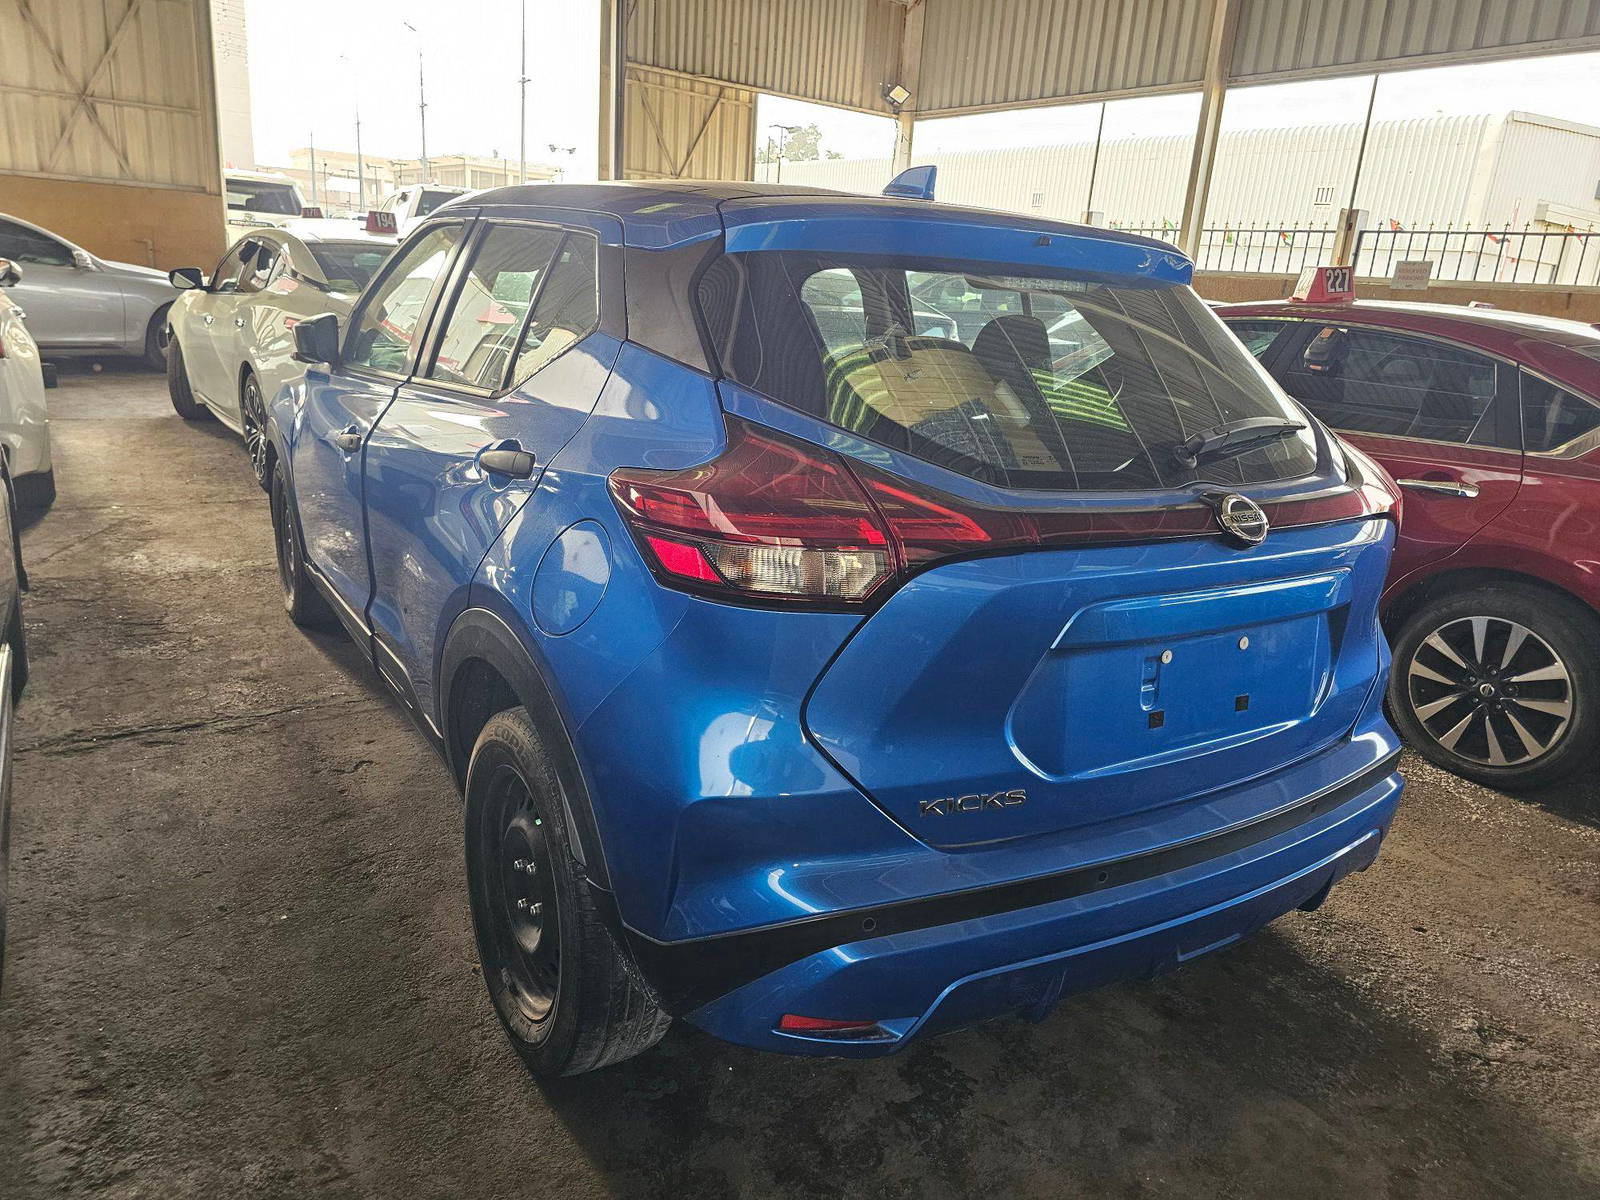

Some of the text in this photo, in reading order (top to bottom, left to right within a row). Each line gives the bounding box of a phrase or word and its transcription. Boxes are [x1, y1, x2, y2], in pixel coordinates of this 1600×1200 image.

[375, 212, 395, 227] 194
[1326, 268, 1350, 293] 227
[1231, 513, 1264, 523] NISSAN
[919, 789, 1027, 818] KICKS
